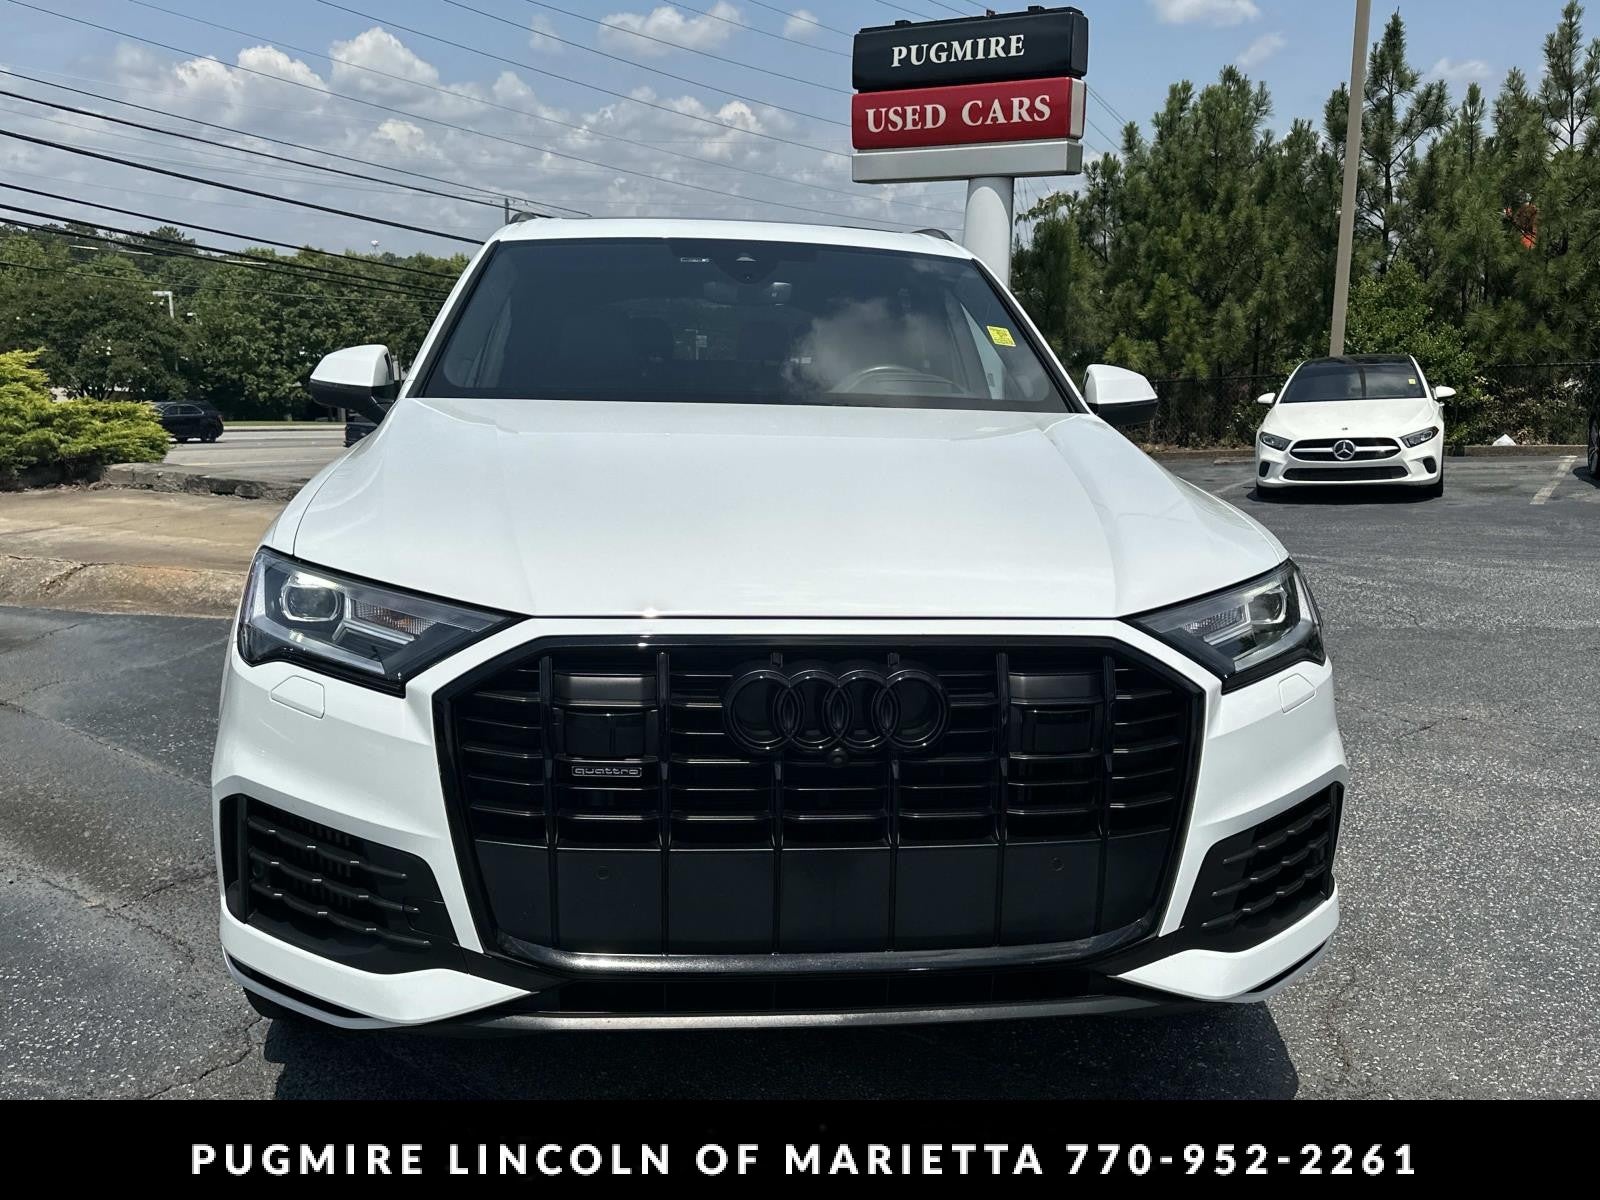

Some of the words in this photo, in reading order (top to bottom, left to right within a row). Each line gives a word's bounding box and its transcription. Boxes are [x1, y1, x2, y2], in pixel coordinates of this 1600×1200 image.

[891, 34, 1025, 67] PUGMIRE
[866, 104, 947, 133] USED
[961, 95, 1051, 126] CARS
[574, 767, 639, 775] quattro
